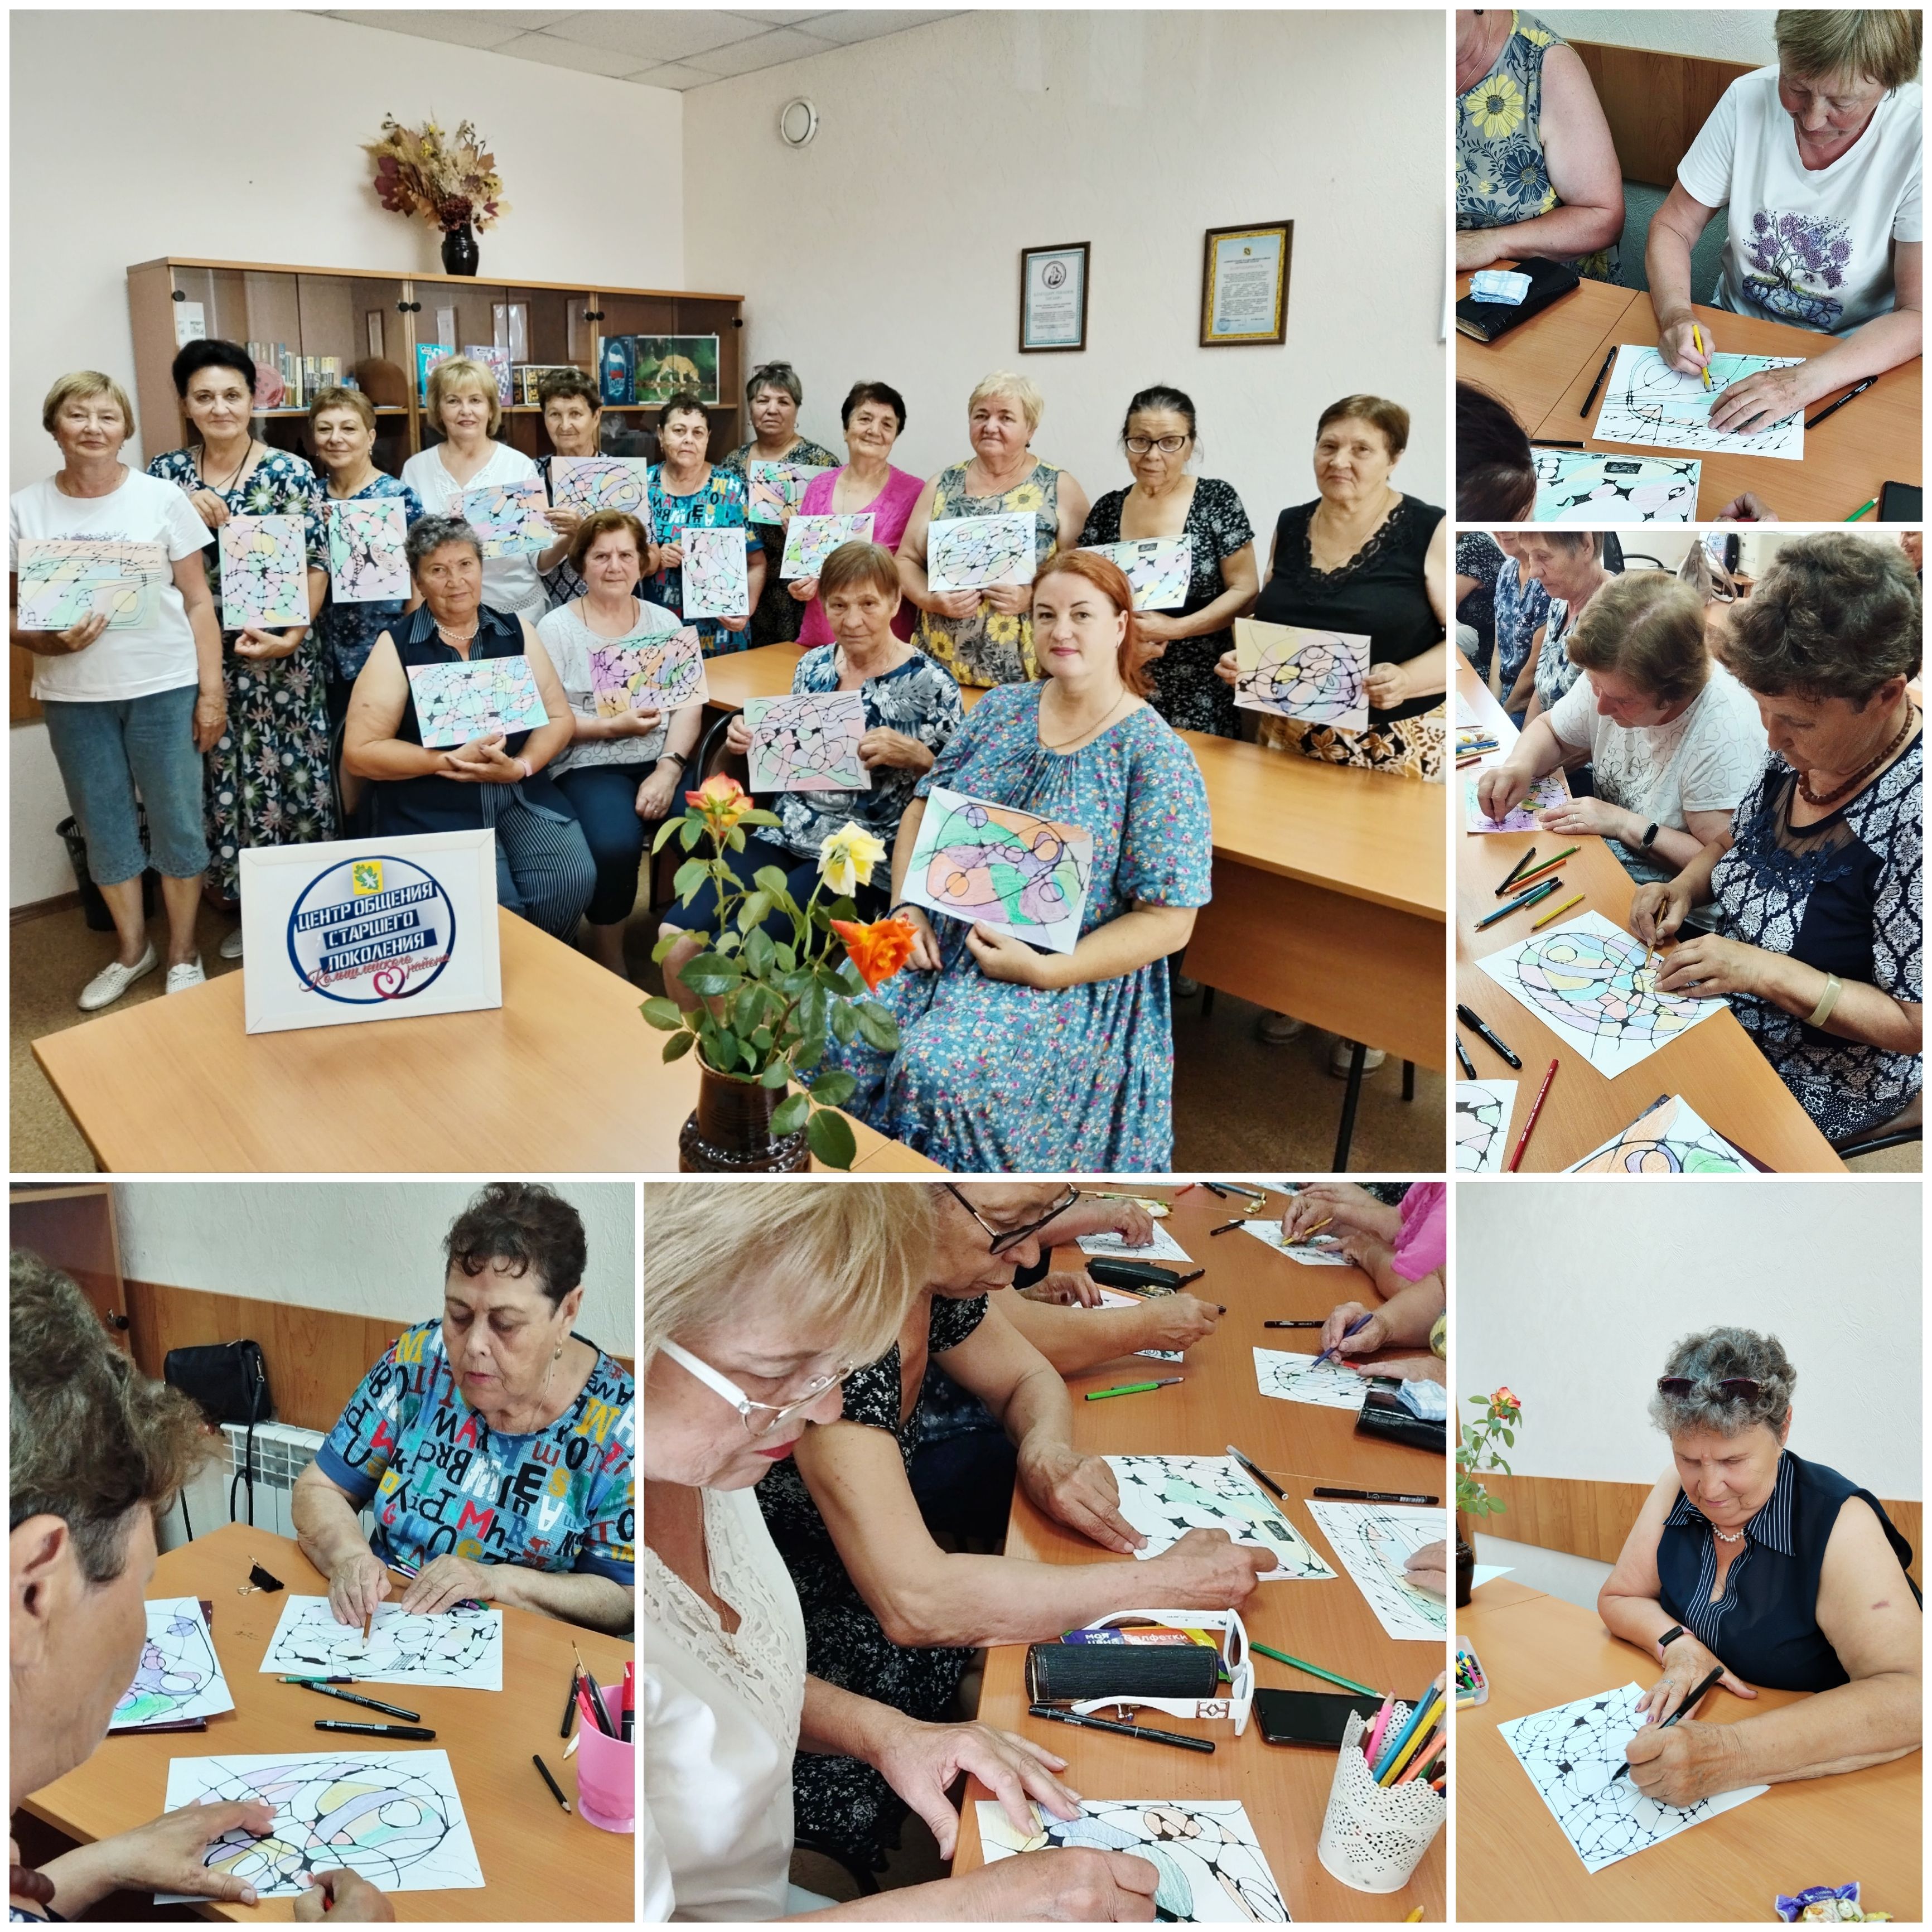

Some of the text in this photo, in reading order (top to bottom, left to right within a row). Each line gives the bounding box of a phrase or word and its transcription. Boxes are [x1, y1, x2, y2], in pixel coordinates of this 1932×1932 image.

[298, 881, 433, 931] ЦЕНТР ОБЩЕНИЯ
[329, 911, 413, 946] СТАРШЕГО
[329, 932, 424, 972] ПОКОЛЕНИЯ
[405, 951, 450, 979] района
[1085, 1632, 1111, 1640] моя
